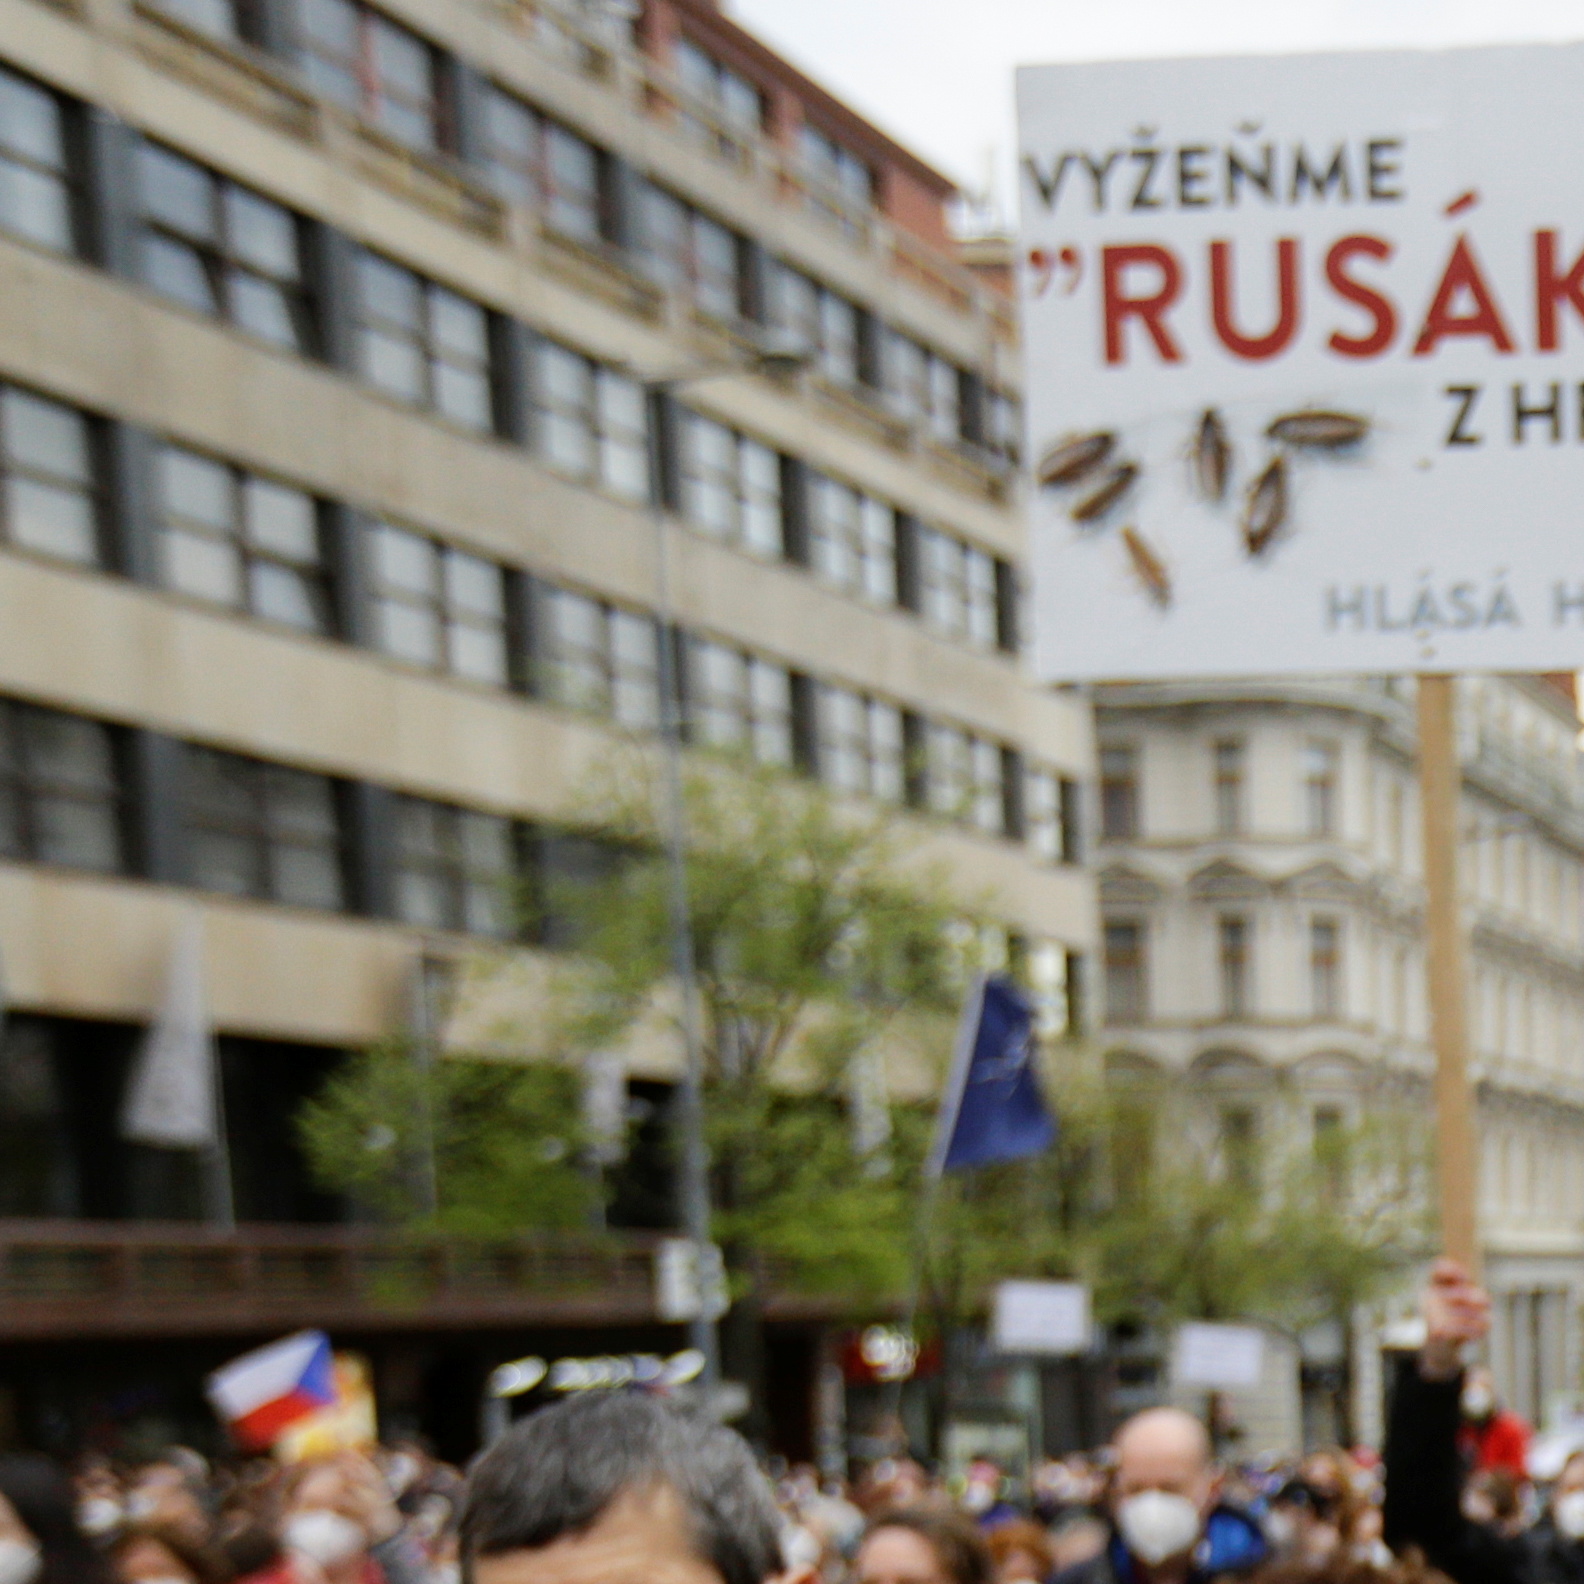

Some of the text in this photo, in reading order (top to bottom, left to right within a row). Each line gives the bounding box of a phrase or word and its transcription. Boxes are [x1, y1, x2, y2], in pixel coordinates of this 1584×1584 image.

[1022, 119, 1408, 215] VYŽEŇME
[1445, 384, 1486, 448] Z
[1322, 567, 1523, 634] HLÁSÁ
